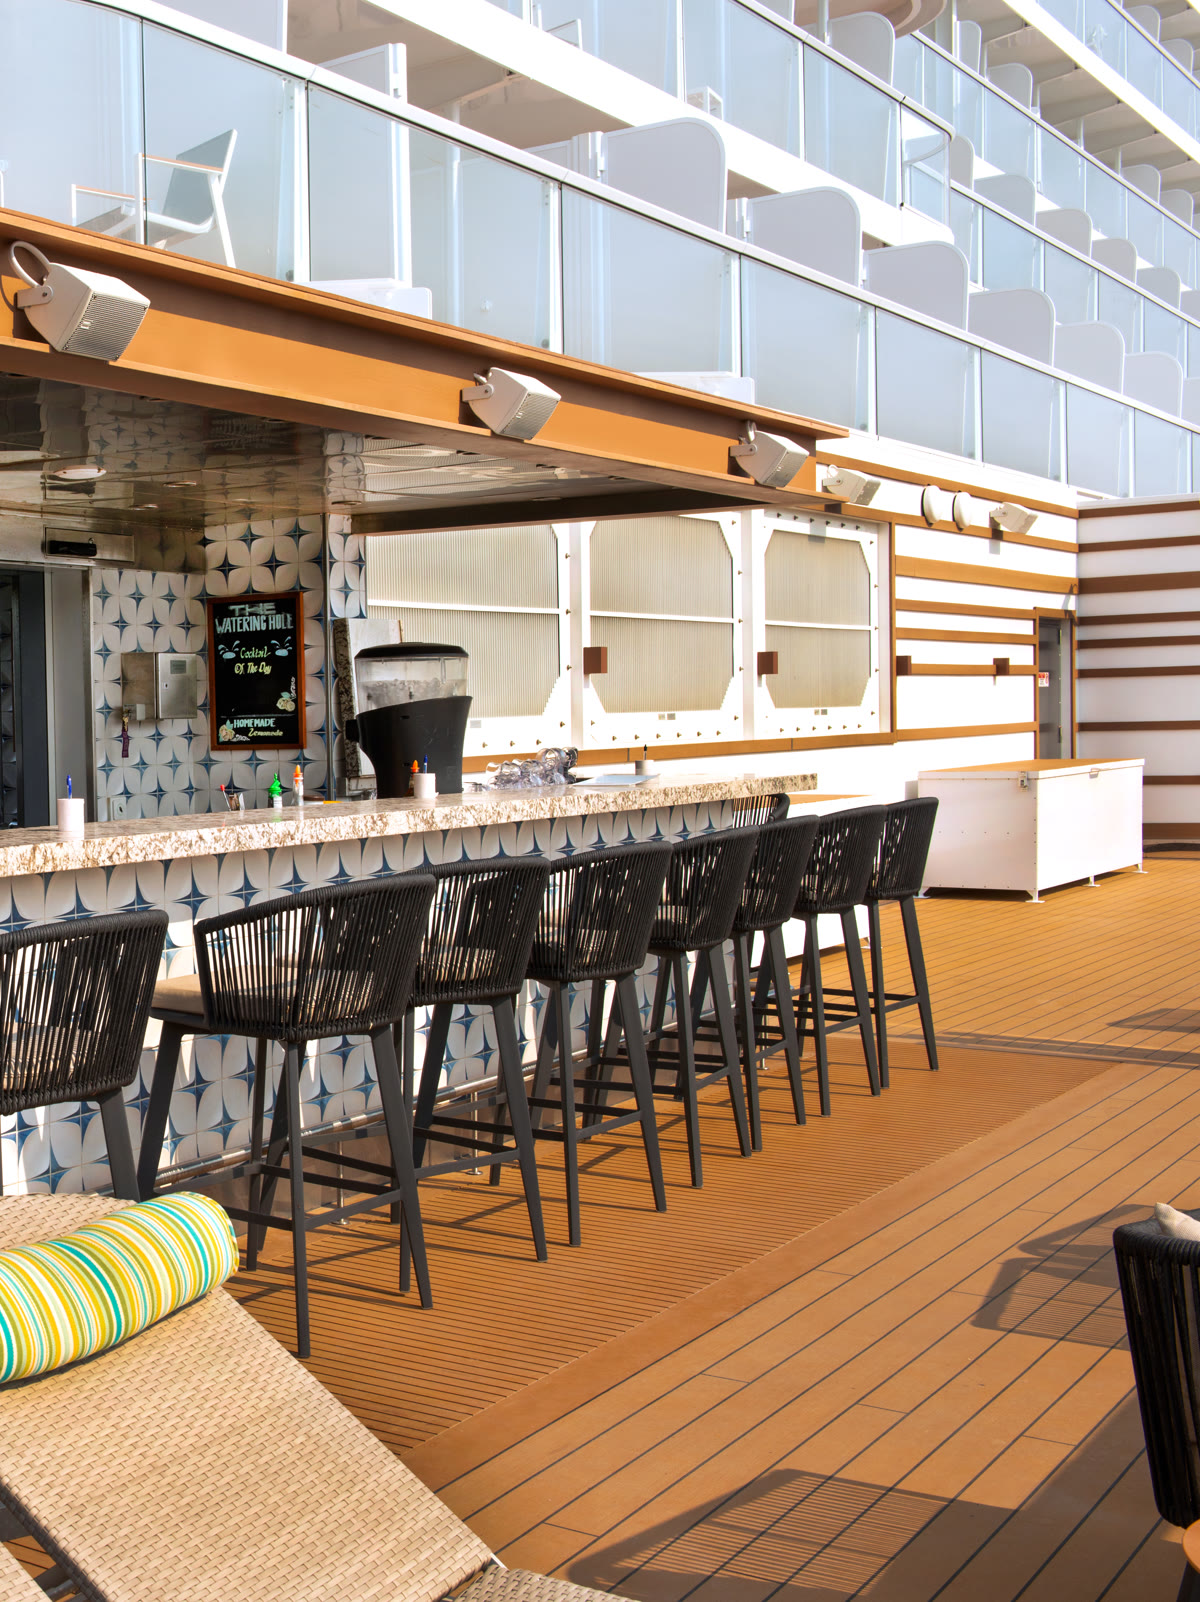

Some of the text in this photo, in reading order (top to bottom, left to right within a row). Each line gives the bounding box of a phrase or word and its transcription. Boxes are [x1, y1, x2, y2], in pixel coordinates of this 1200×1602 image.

[228, 602, 277, 616] THE
[215, 612, 294, 634] WATERING HOLE
[240, 646, 271, 659] Cocktail
[233, 717, 276, 729] HOMEMADE
